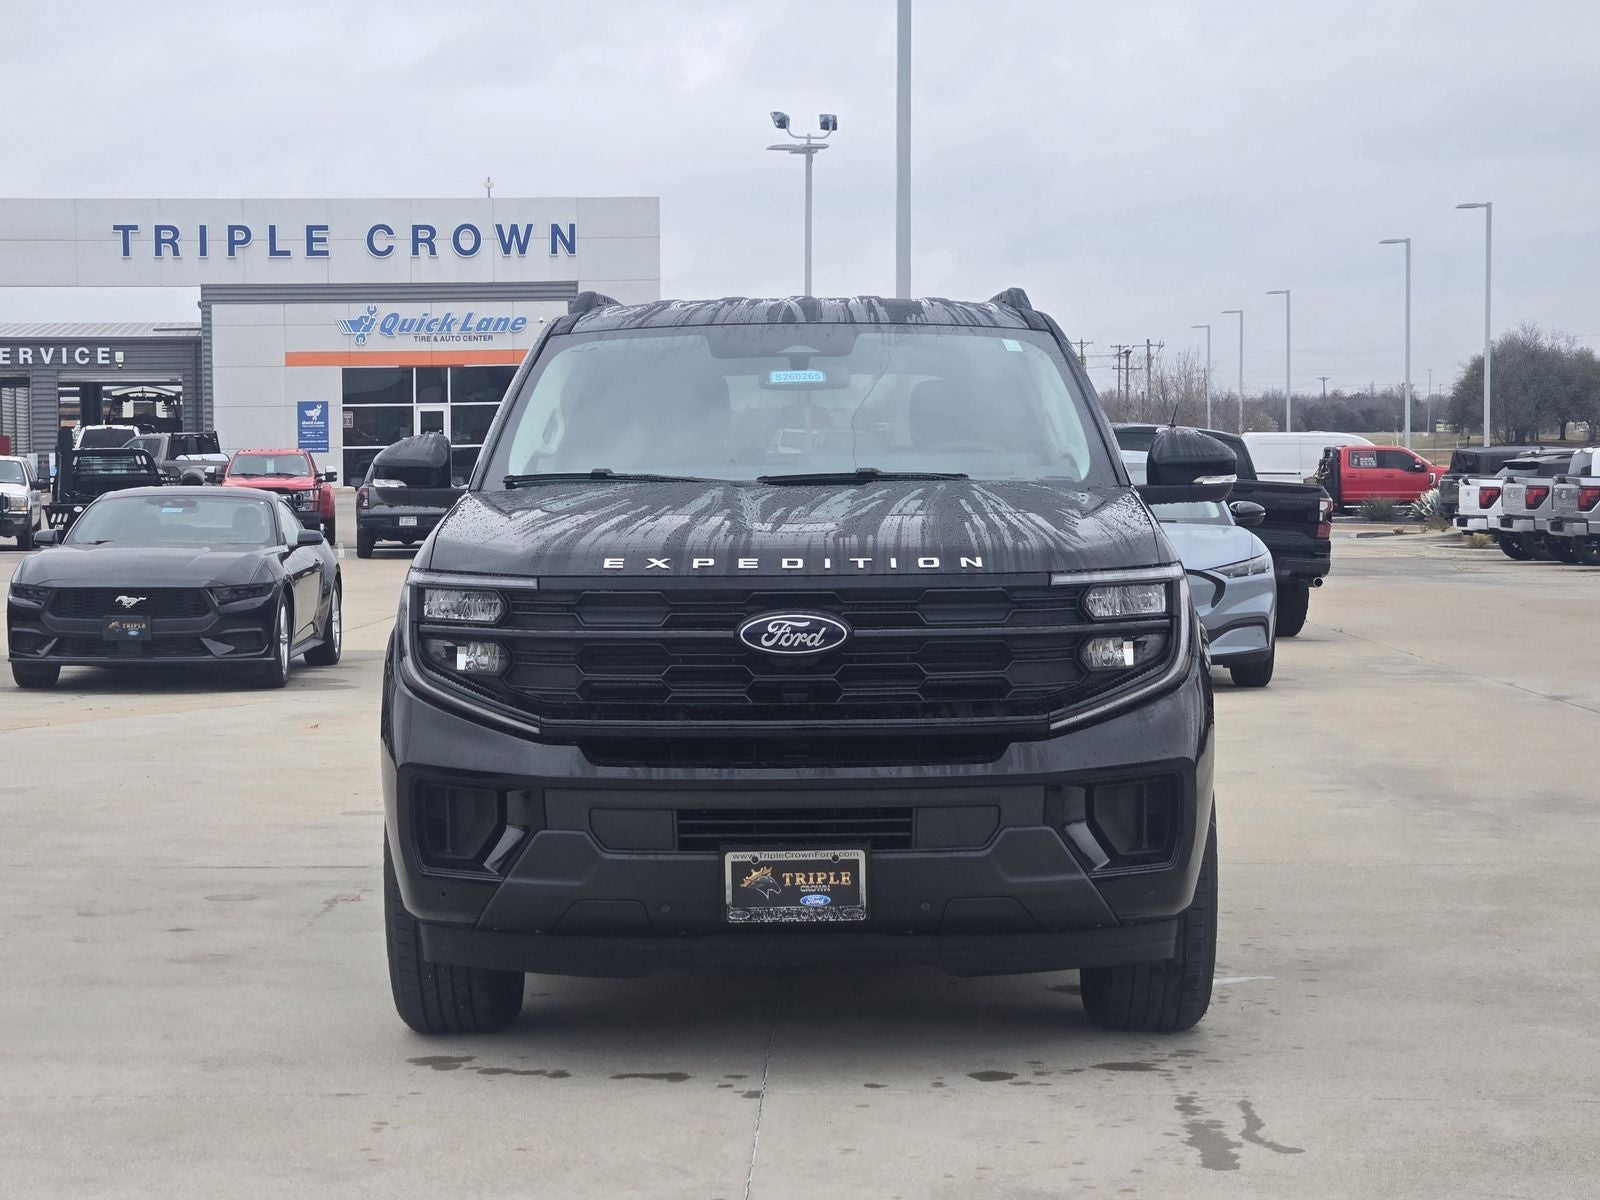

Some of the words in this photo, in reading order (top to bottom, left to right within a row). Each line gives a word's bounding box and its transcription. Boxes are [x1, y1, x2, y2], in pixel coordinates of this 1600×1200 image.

[112, 224, 330, 258] TRIPLE
[365, 223, 576, 258] CROWN
[379, 312, 458, 337] Quick
[459, 312, 528, 334] Lane
[413, 335, 431, 343] TIRE
[433, 335, 438, 343] &
[462, 334, 493, 342] CENTER
[0, 347, 110, 364] ERVICE
[775, 372, 821, 381] S260265
[603, 557, 983, 570] EXPEDITION
[760, 620, 826, 648] Ford
[732, 851, 859, 860] wwwTripleCrownFordcom
[782, 871, 852, 886] TRIPLE
[800, 885, 831, 893] CROWN
